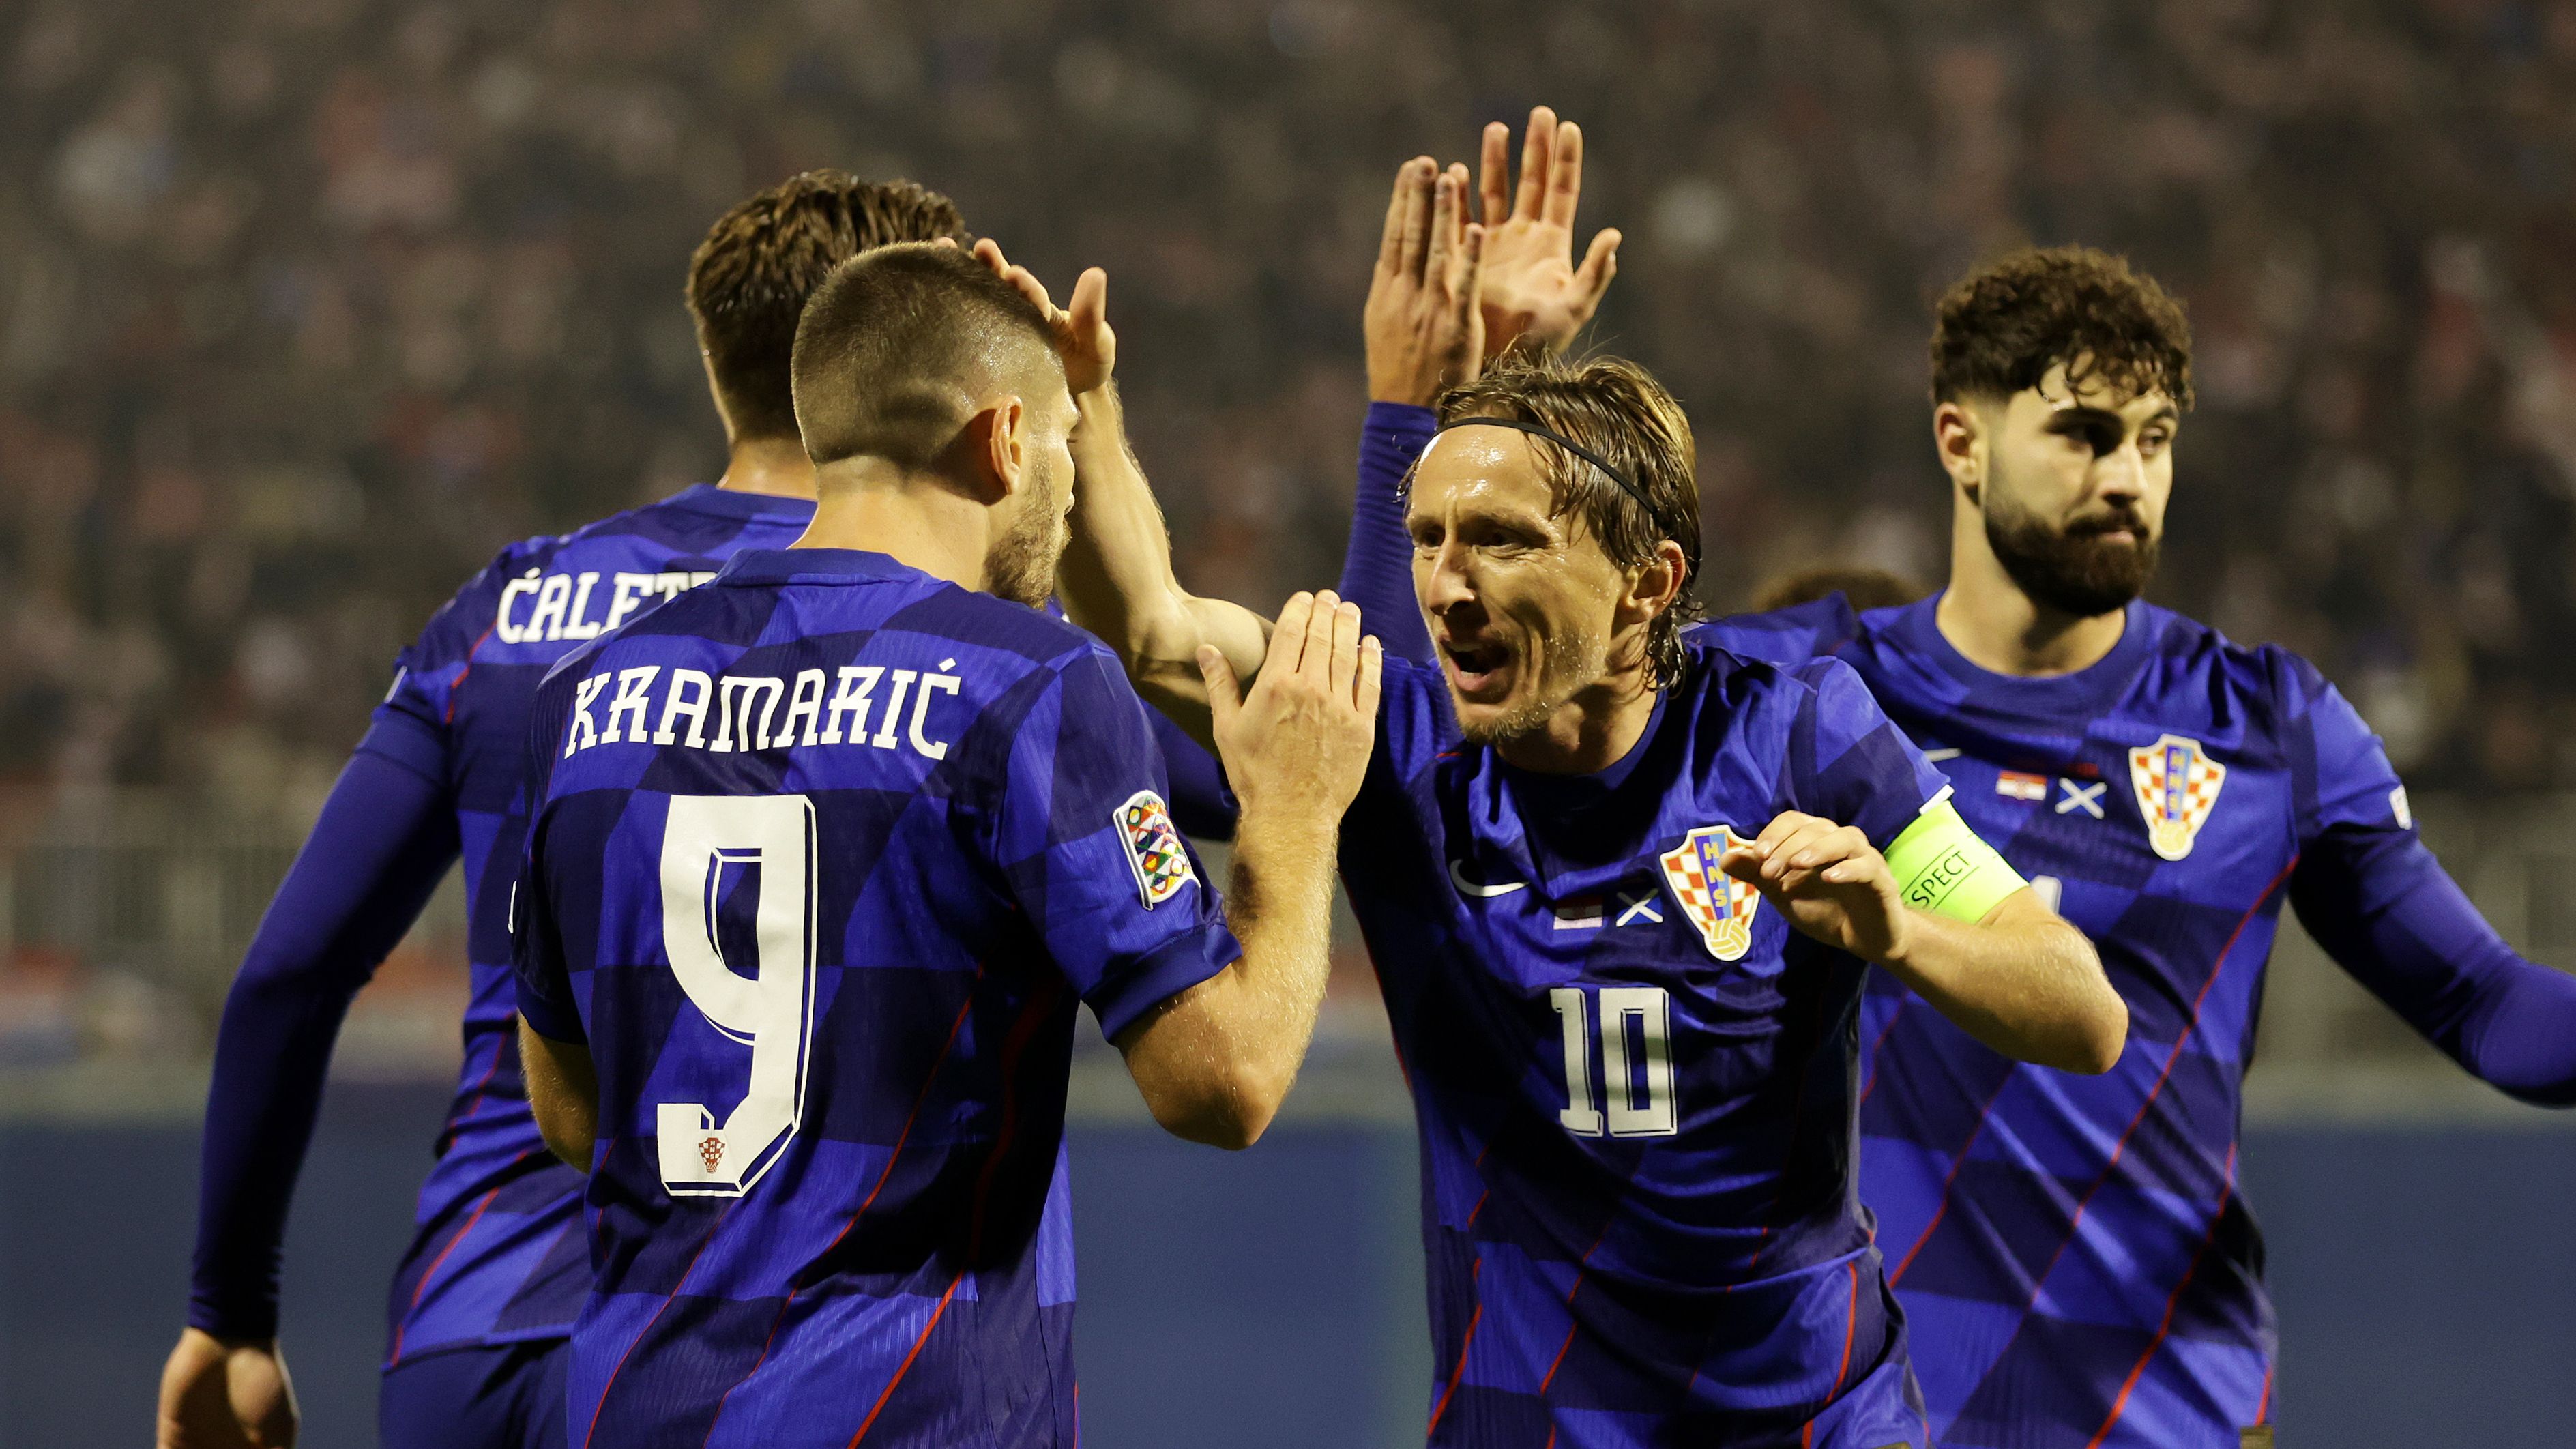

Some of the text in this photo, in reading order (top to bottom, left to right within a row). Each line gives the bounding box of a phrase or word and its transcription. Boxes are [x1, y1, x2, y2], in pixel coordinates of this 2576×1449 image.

[564, 658, 961, 760] KRAMARIĆ
[1703, 841, 1728, 907] HNS
[1904, 850, 1970, 909] SPECT
[656, 794, 819, 1198] 9
[1550, 987, 1678, 1138] 10
